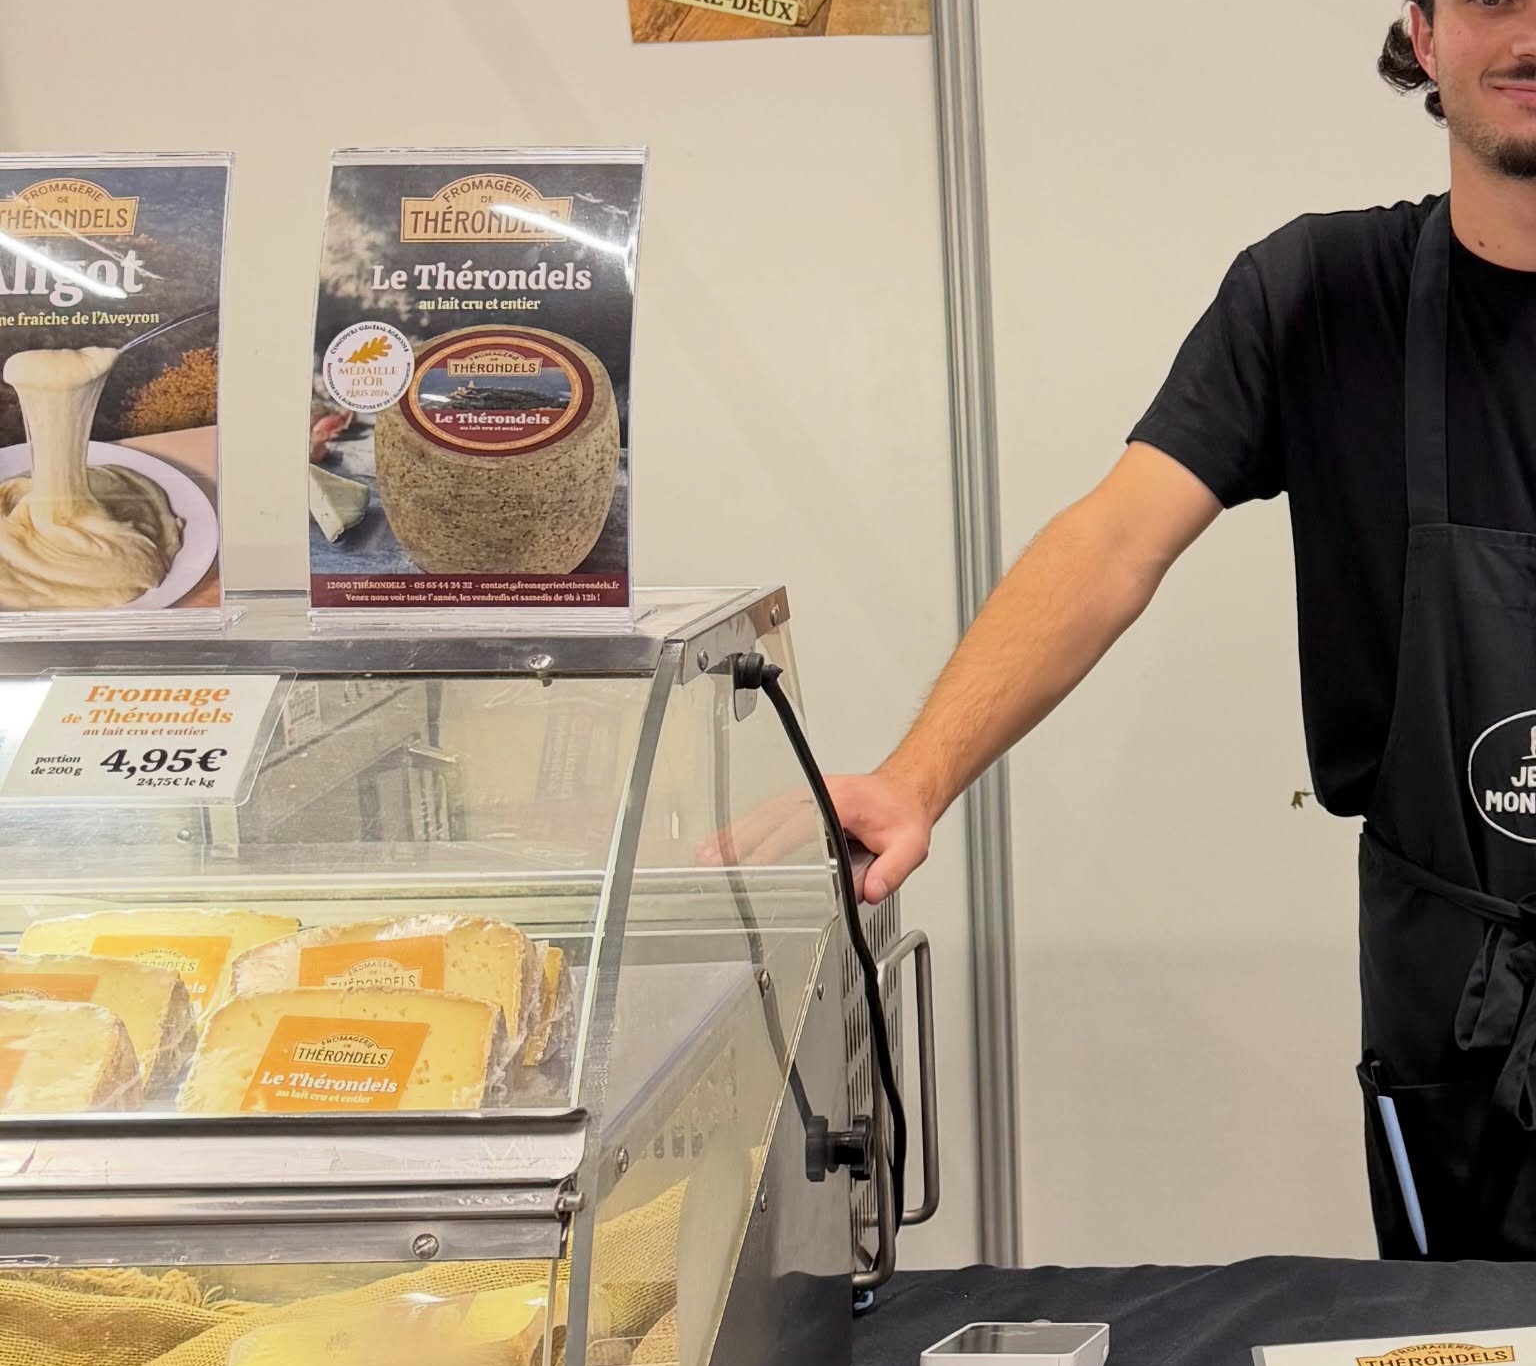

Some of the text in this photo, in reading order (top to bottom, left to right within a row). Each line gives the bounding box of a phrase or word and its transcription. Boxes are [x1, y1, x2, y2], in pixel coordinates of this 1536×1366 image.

[24, 182, 104, 203] FROMAGERIE
[443, 180, 533, 204] FROMAGERIE
[481, 195, 494, 204] DE
[371, 260, 592, 291] Le Thérondels
[418, 297, 540, 310] au lait cru et entier
[18, 310, 159, 326] fraîche de l'Aveyron
[453, 362, 536, 374] THÉRONDELS
[435, 412, 550, 425] Le Thérondels
[85, 685, 230, 706] Fromage
[61, 707, 233, 724] de Thérondels
[82, 726, 208, 736] au lait cru et entier
[35, 754, 81, 766] portion
[100, 748, 228, 779] 4,95€
[30, 765, 83, 776] de 200 g
[136, 776, 216, 788] 24,75€ le kg
[299, 1047, 388, 1066] THÉRONDELS
[261, 1071, 398, 1093] Le Thérondels
